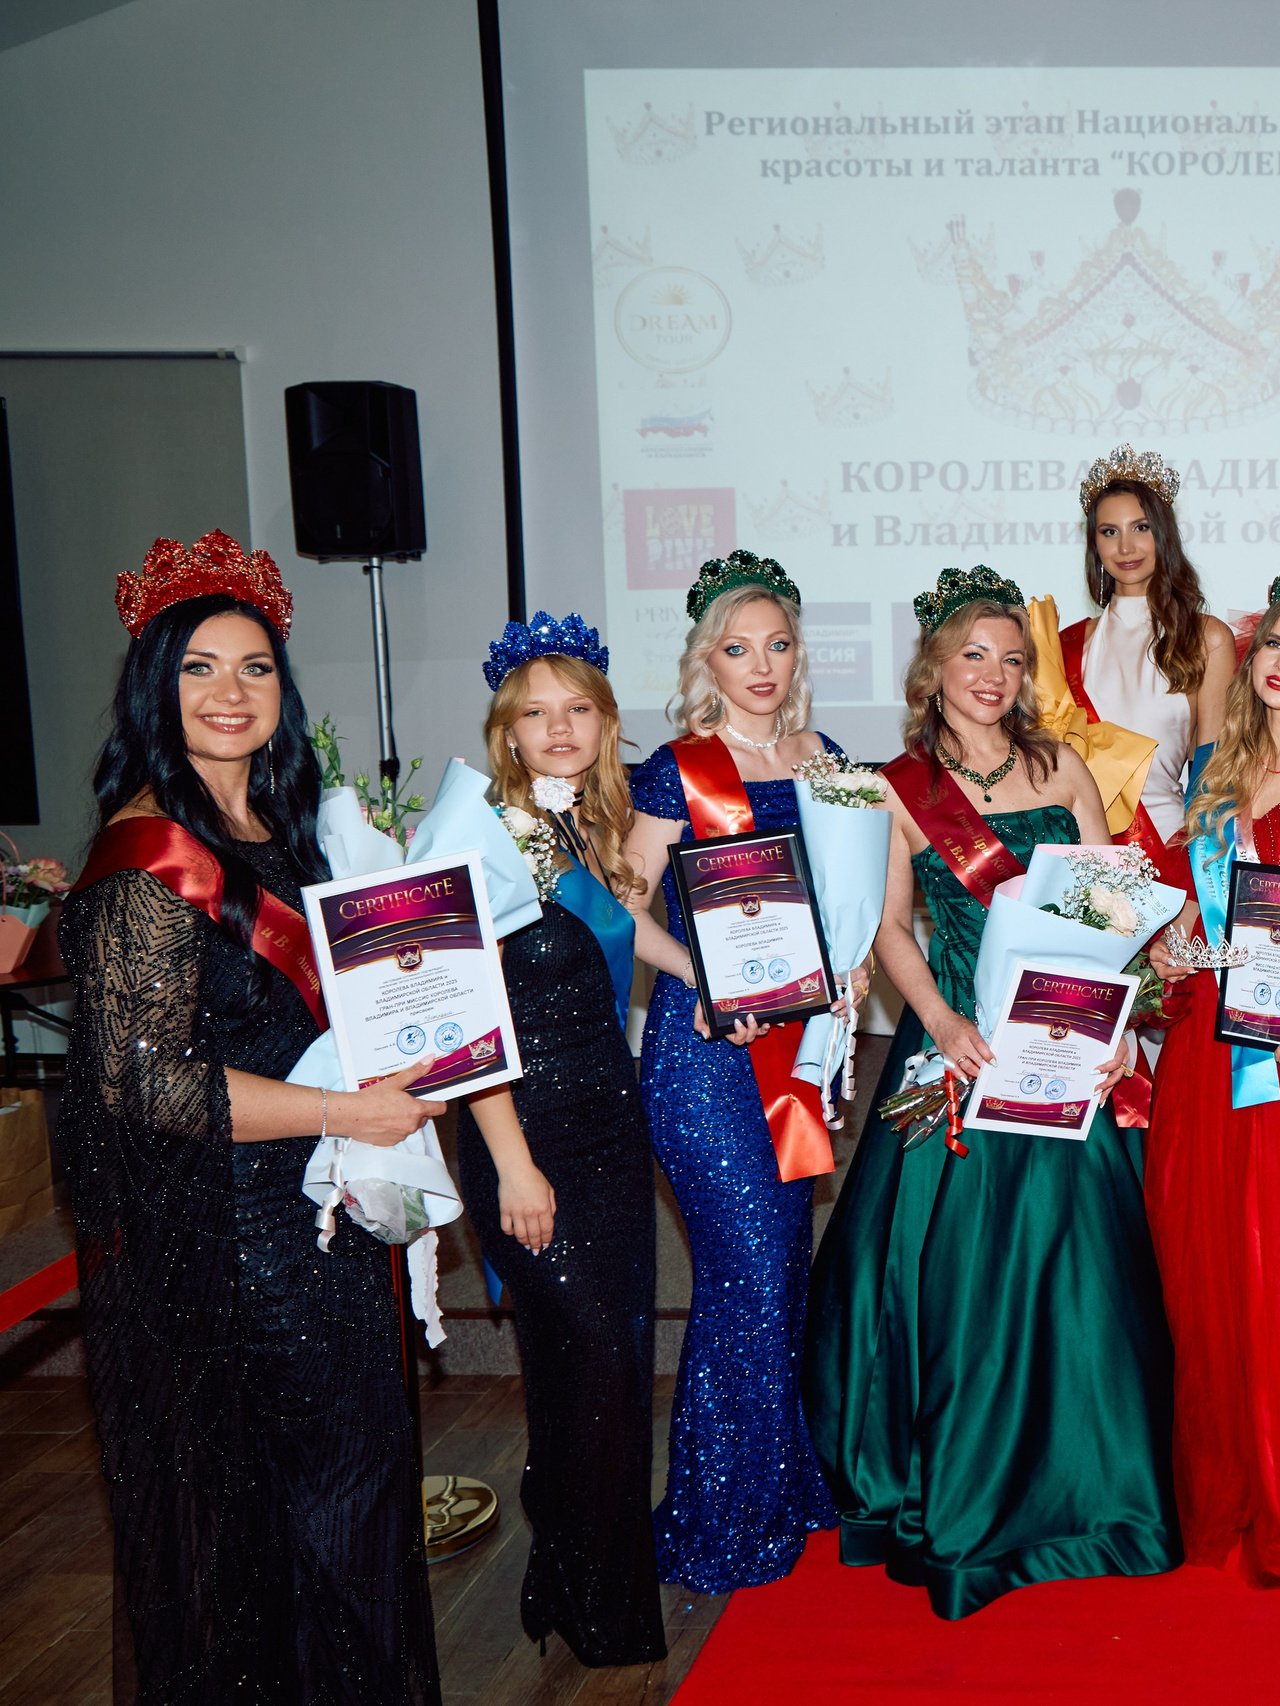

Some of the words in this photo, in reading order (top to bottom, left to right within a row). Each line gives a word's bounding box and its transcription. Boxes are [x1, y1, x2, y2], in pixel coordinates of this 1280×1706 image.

[704, 109, 975, 136] Региональный
[985, 116, 1065, 136] этап
[760, 157, 912, 184] красоты
[924, 157, 944, 177] и
[955, 156, 1101, 178] таланта
[630, 313, 718, 334] DREAM
[656, 333, 694, 345] TOUR
[645, 504, 715, 538] LOVE
[831, 522, 858, 548] и
[943, 836, 955, 848] и
[953, 808, 993, 858] Гран-При
[696, 845, 784, 872] CERTIFICATE
[339, 877, 455, 920] CERTIFICATE
[375, 989, 420, 1005] ВЛАДИМИРСКОЙ
[420, 982, 445, 993] ОБЛАСТИ
[445, 978, 458, 986] 2025
[379, 1001, 405, 1012] ГРАН-ПРИ
[406, 994, 430, 1004] МИССИС
[430, 986, 459, 997] КОРОЛЕВА
[381, 984, 410, 996] КОРОЛЕВА
[410, 975, 444, 988] ВЛАДИМИРА
[1031, 977, 1115, 1001] CERTIFICATE
[364, 1009, 399, 1022] ВЛАДИМИРА
[404, 995, 449, 1012] ВЛАДИМИРСКОЙ
[449, 987, 475, 999] ОБЛАСТИ
